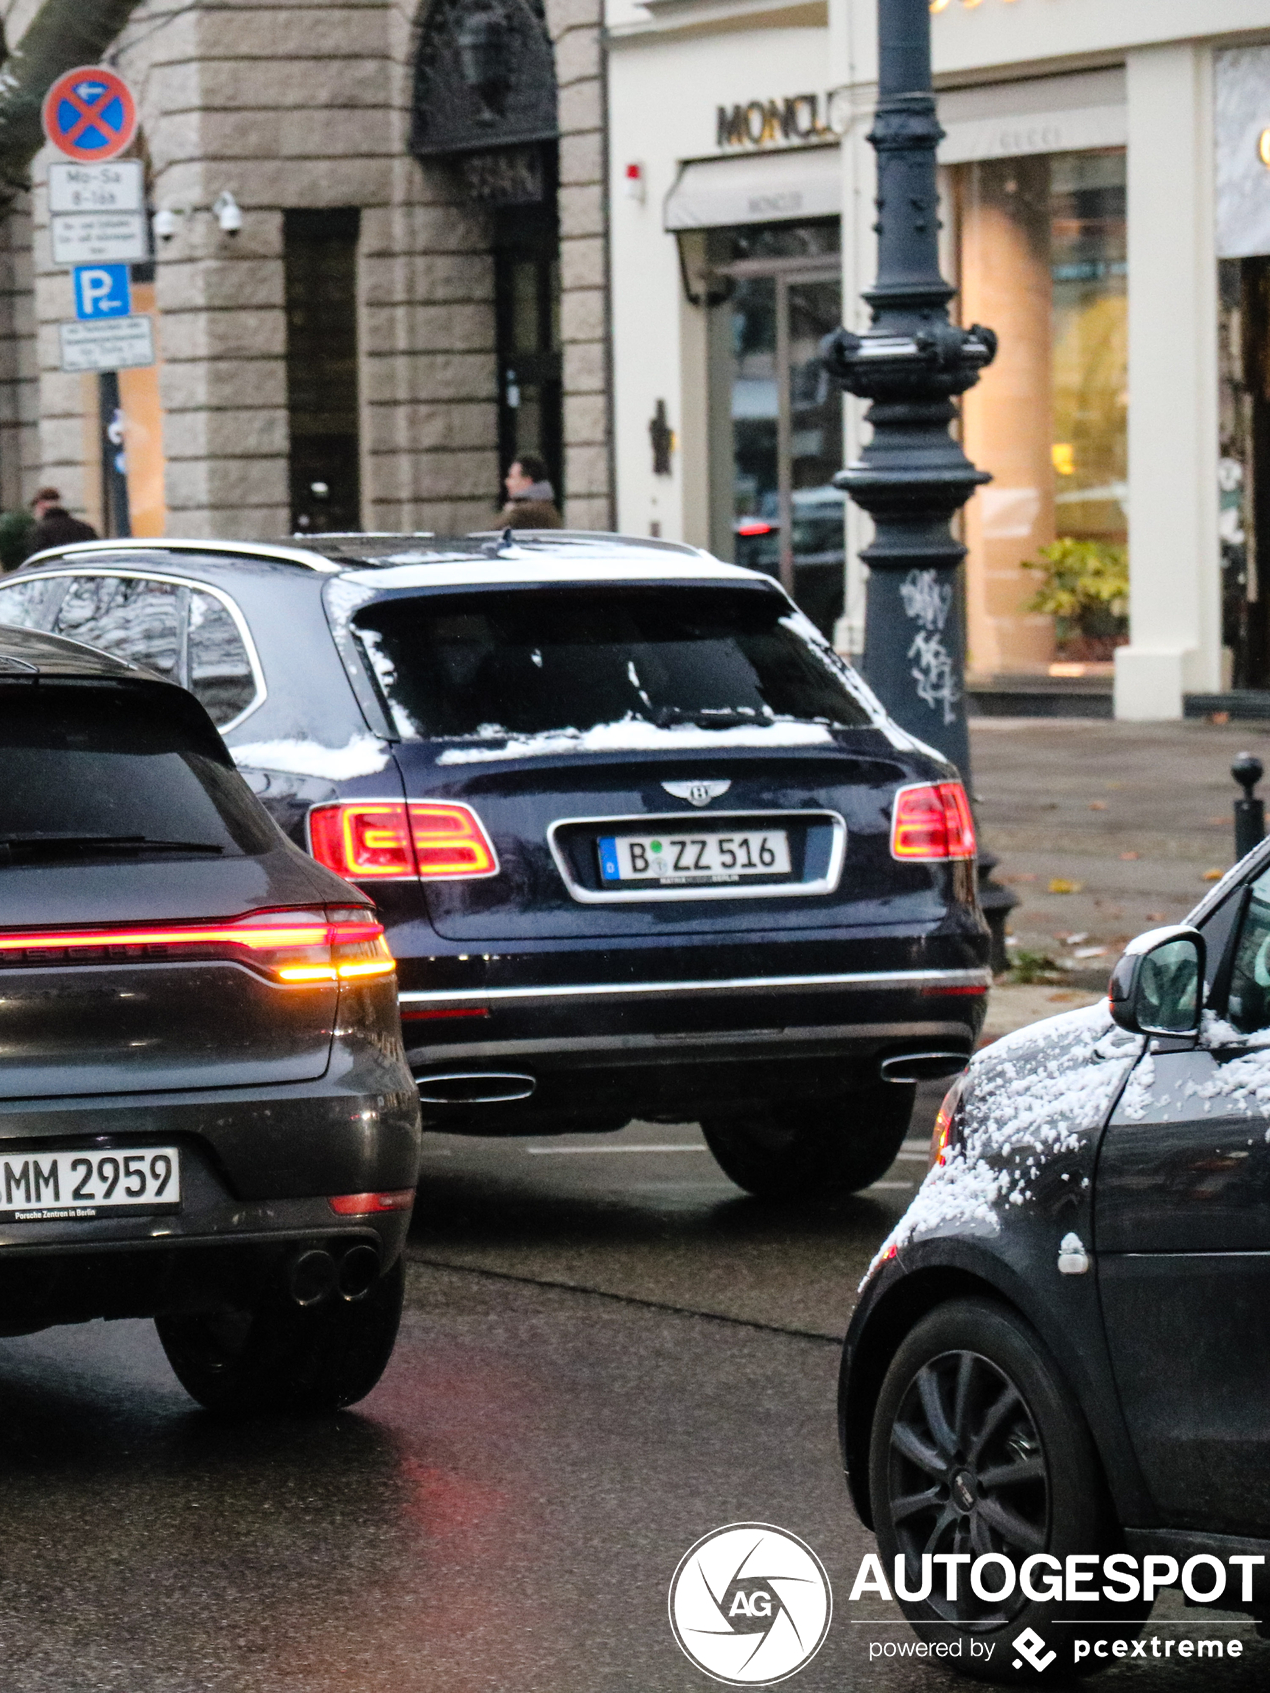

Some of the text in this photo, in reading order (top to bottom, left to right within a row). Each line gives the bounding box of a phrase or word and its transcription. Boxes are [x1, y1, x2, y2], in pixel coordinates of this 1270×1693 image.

[66, 168, 122, 184] Mo-Sa
[80, 270, 113, 315] P
[630, 837, 776, 873] B ZZ 516
[3, 1159, 61, 1205] MM
[70, 1154, 173, 1201] 2959
[14, 1208, 96, 1220] Porsche Zentren in Berlin
